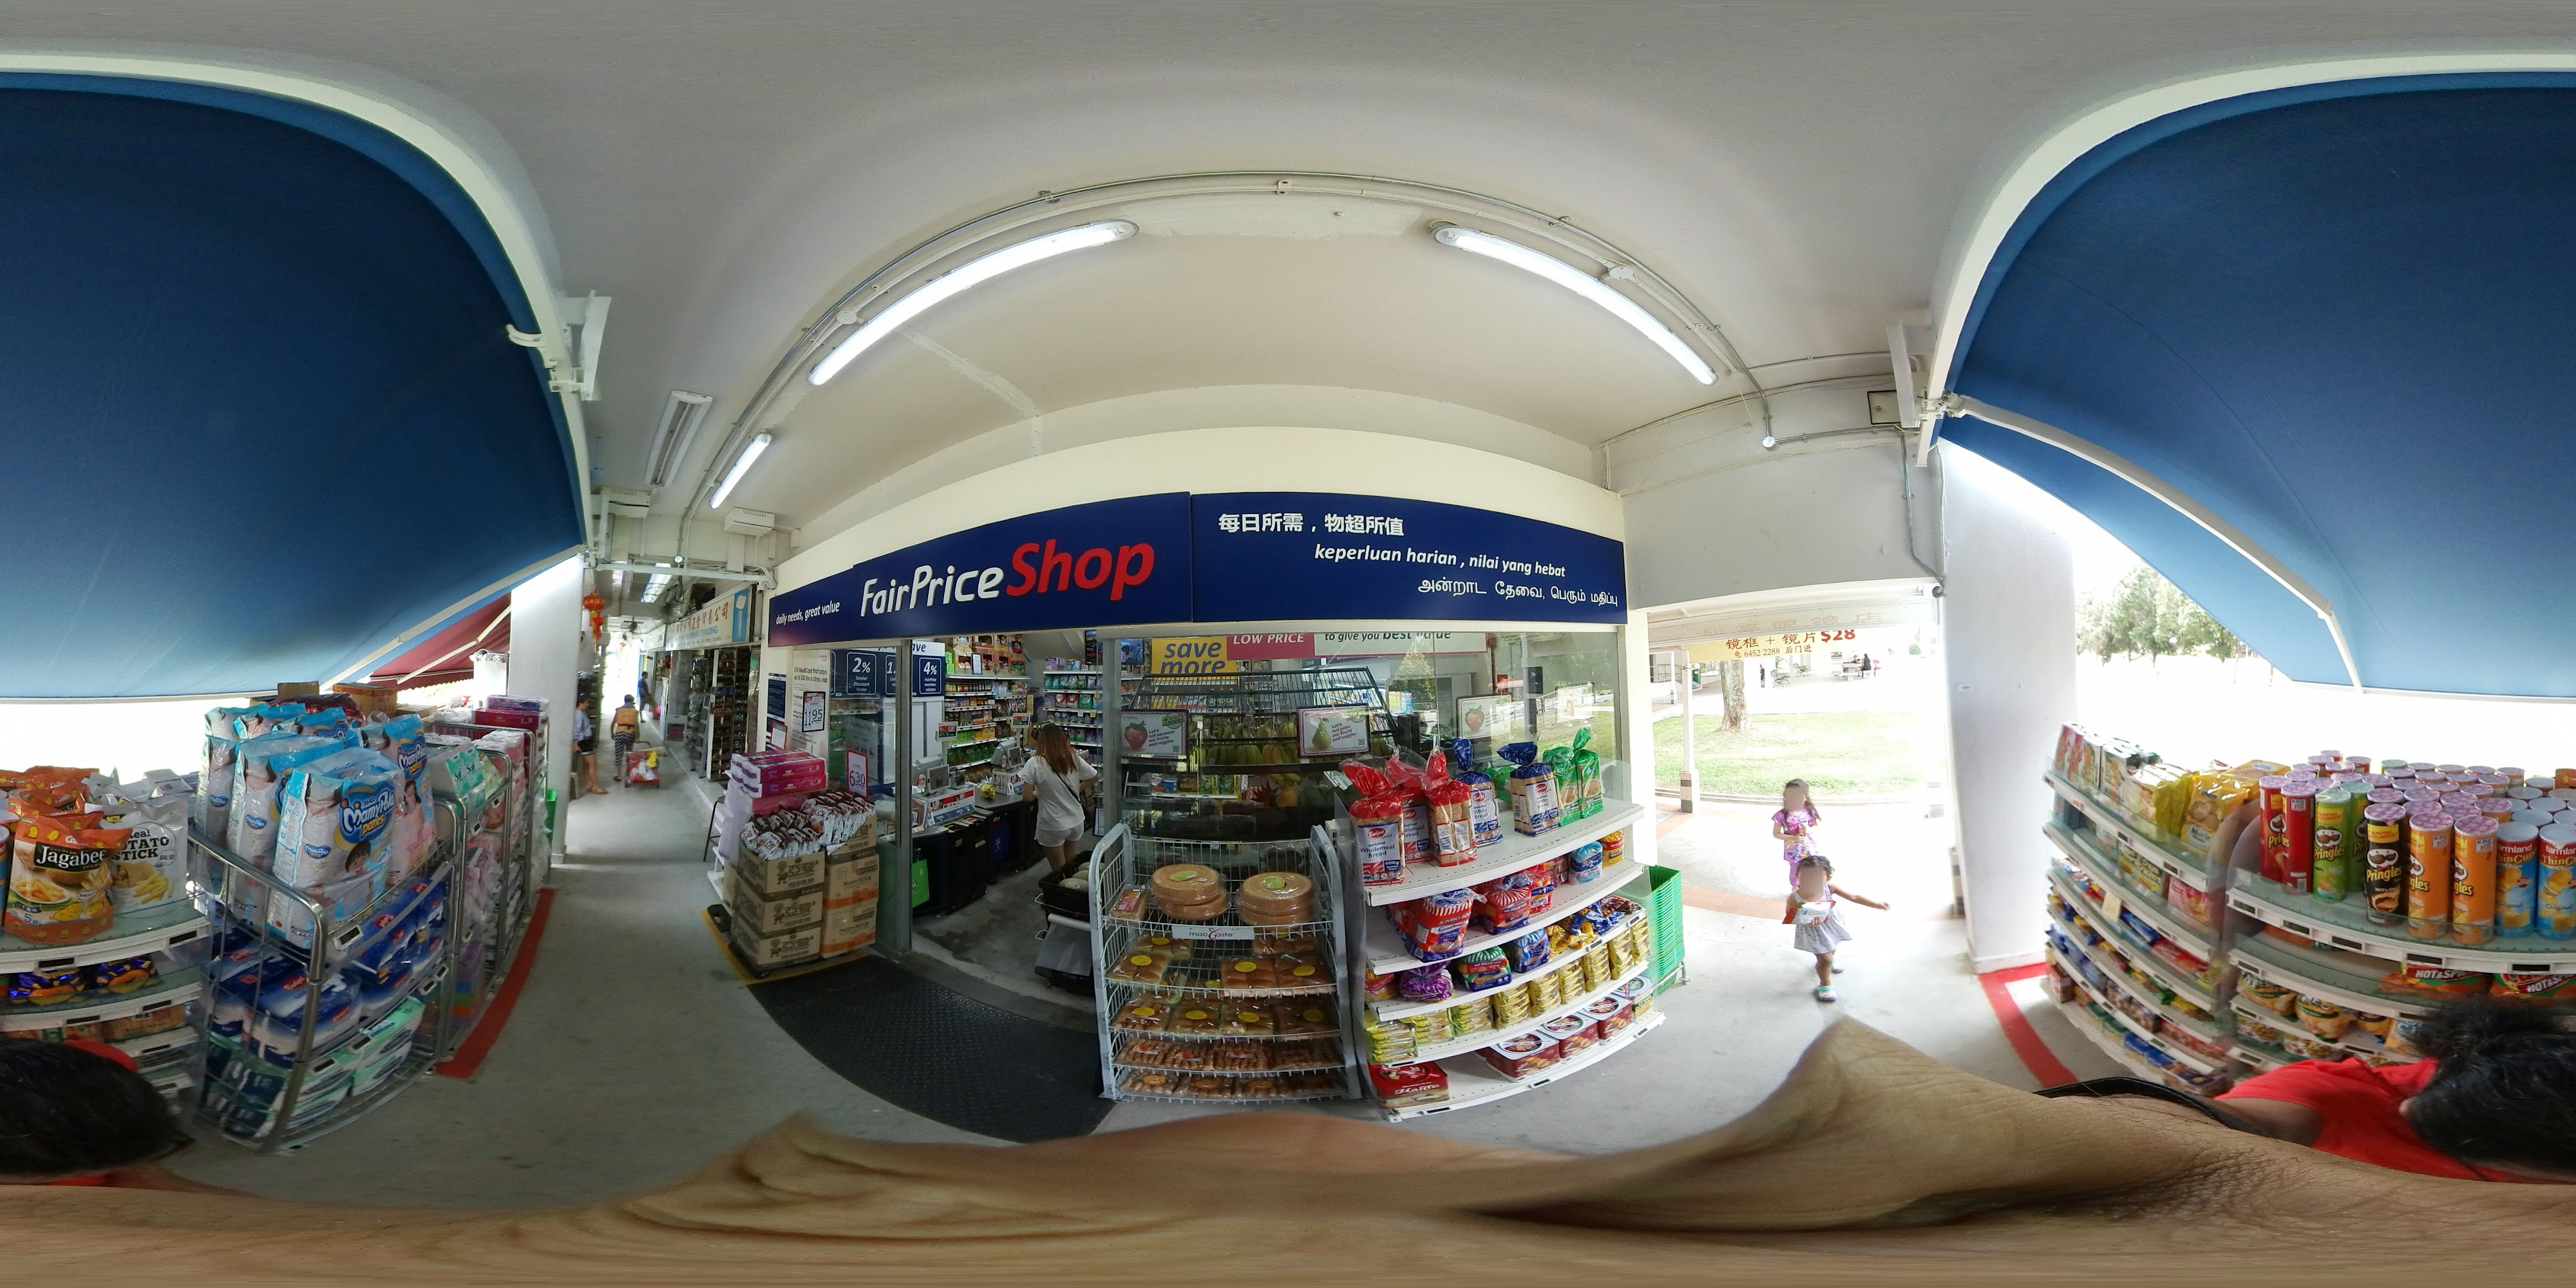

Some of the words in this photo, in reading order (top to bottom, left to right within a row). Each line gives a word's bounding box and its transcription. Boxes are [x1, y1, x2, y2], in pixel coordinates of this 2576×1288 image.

[1314, 544, 1401, 562] keperluan
[1406, 549, 1457, 566] harian
[1469, 554, 1499, 569] nilai
[1502, 558, 1532, 574] yang
[1534, 562, 1566, 577] hebat
[860, 565, 1005, 618] FairPrice
[1006, 539, 1154, 600] Shop
[1418, 576, 1487, 597] அன்றாட
[776, 612, 787, 625] daily
[788, 609, 804, 623] needs,
[805, 605, 821, 621] great
[821, 600, 840, 616] value
[1233, 634, 1265, 645] LOW
[1267, 632, 1305, 644] PRICE
[1338, 632, 1362, 643] give
[1363, 633, 1379, 642] you
[1725, 638, 1759, 649] 镜框
[1781, 632, 1816, 645] 镜片
[1821, 629, 1856, 643] $28
[913, 644, 926, 652] ave
[1164, 639, 1222, 659] save
[852, 657, 871, 674] 2%
[923, 661, 937, 675] 4%
[1160, 656, 1226, 675] more
[849, 770, 866, 786] 6.30
[131, 829, 151, 838] eal
[361, 814, 384, 837] pants
[1368, 828, 1385, 838] Budget
[122, 837, 169, 850] TATO
[1360, 844, 1395, 853] Wholemeal
[36, 846, 107, 869] Jagabee
[2315, 847, 2344, 860] Pringles
[2367, 866, 2401, 882] Pringles
[2409, 877, 2430, 891] gles
[2454, 882, 2473, 896] gles
